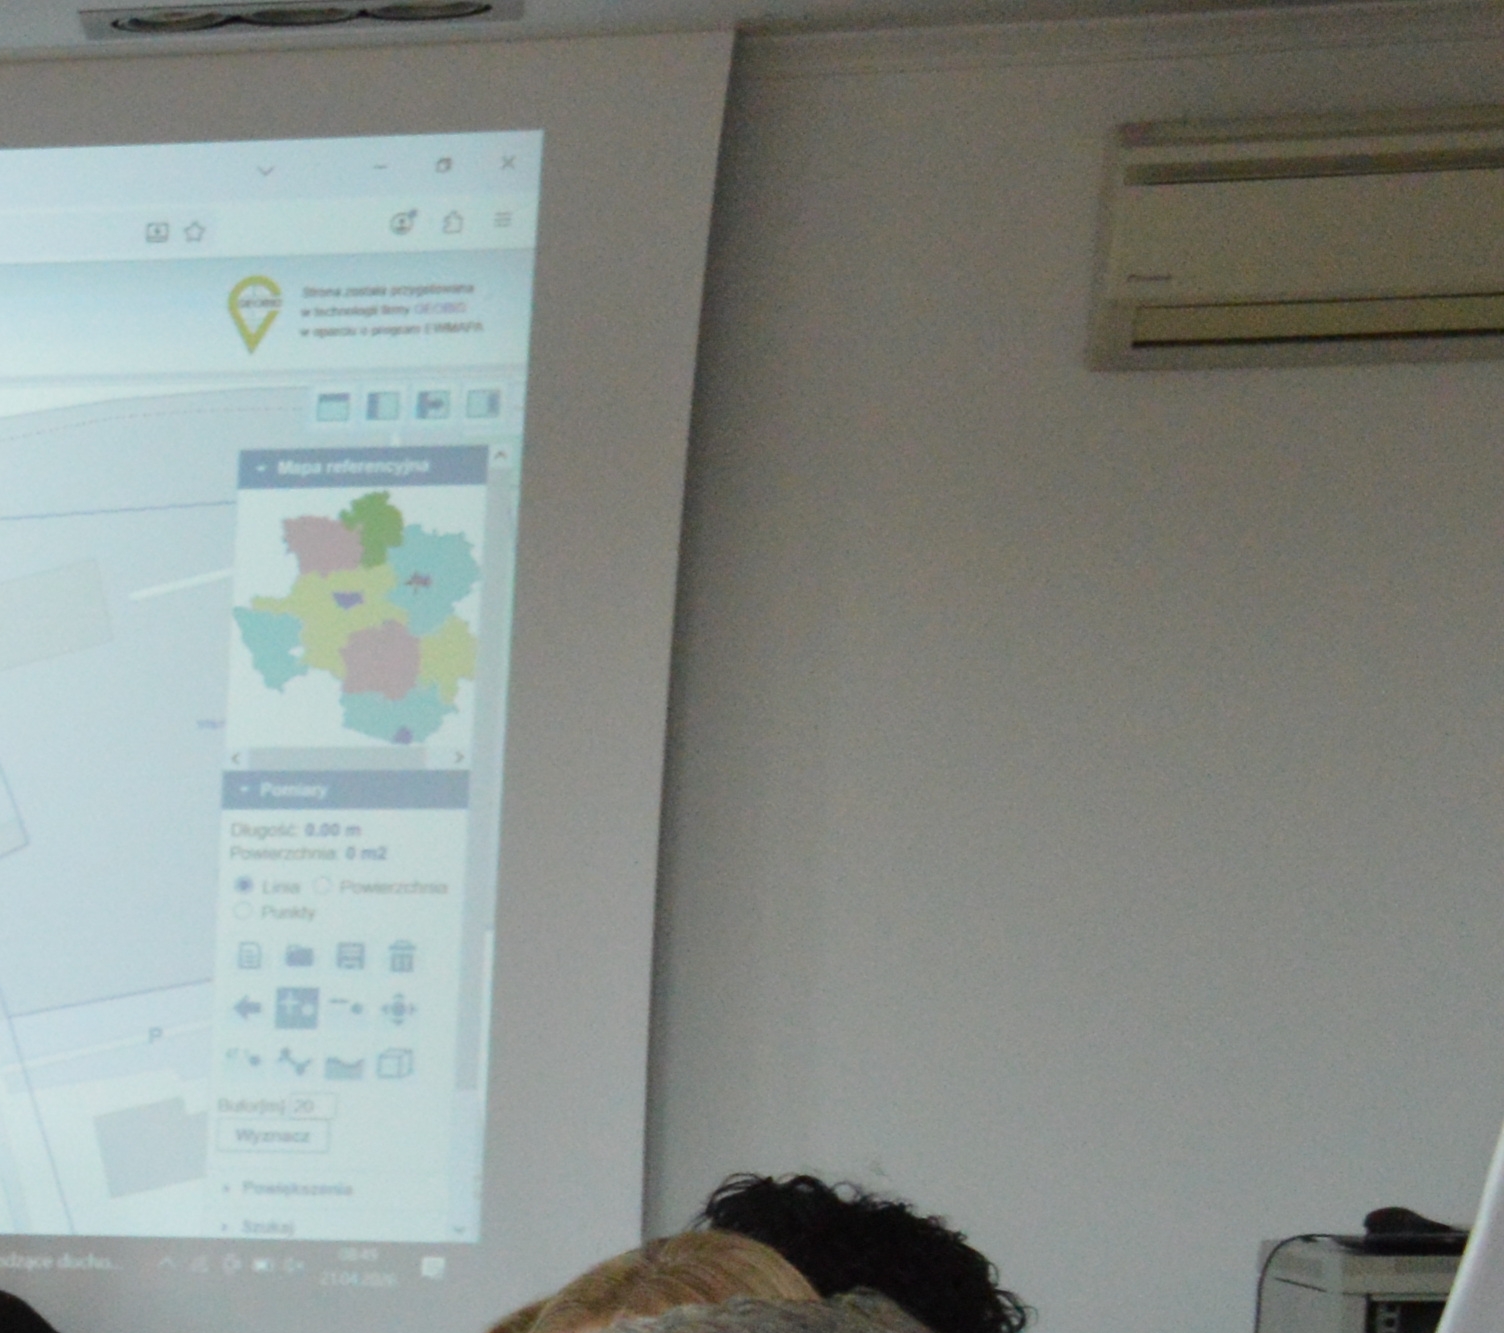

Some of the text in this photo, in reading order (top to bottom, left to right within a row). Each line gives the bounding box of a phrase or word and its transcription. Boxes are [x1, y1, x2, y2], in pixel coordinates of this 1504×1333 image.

[278, 457, 430, 477] Mapa referencyjna
[259, 782, 328, 800] Pomiary
[304, 822, 340, 837] 0.00
[344, 825, 362, 837] m
[345, 845, 355, 859] 0
[360, 845, 387, 859] m2
[340, 880, 448, 894] Powierzchnia
[261, 905, 316, 922] Punkty
[294, 1098, 315, 1113] 20
[235, 1128, 310, 1146] Wyznacz
